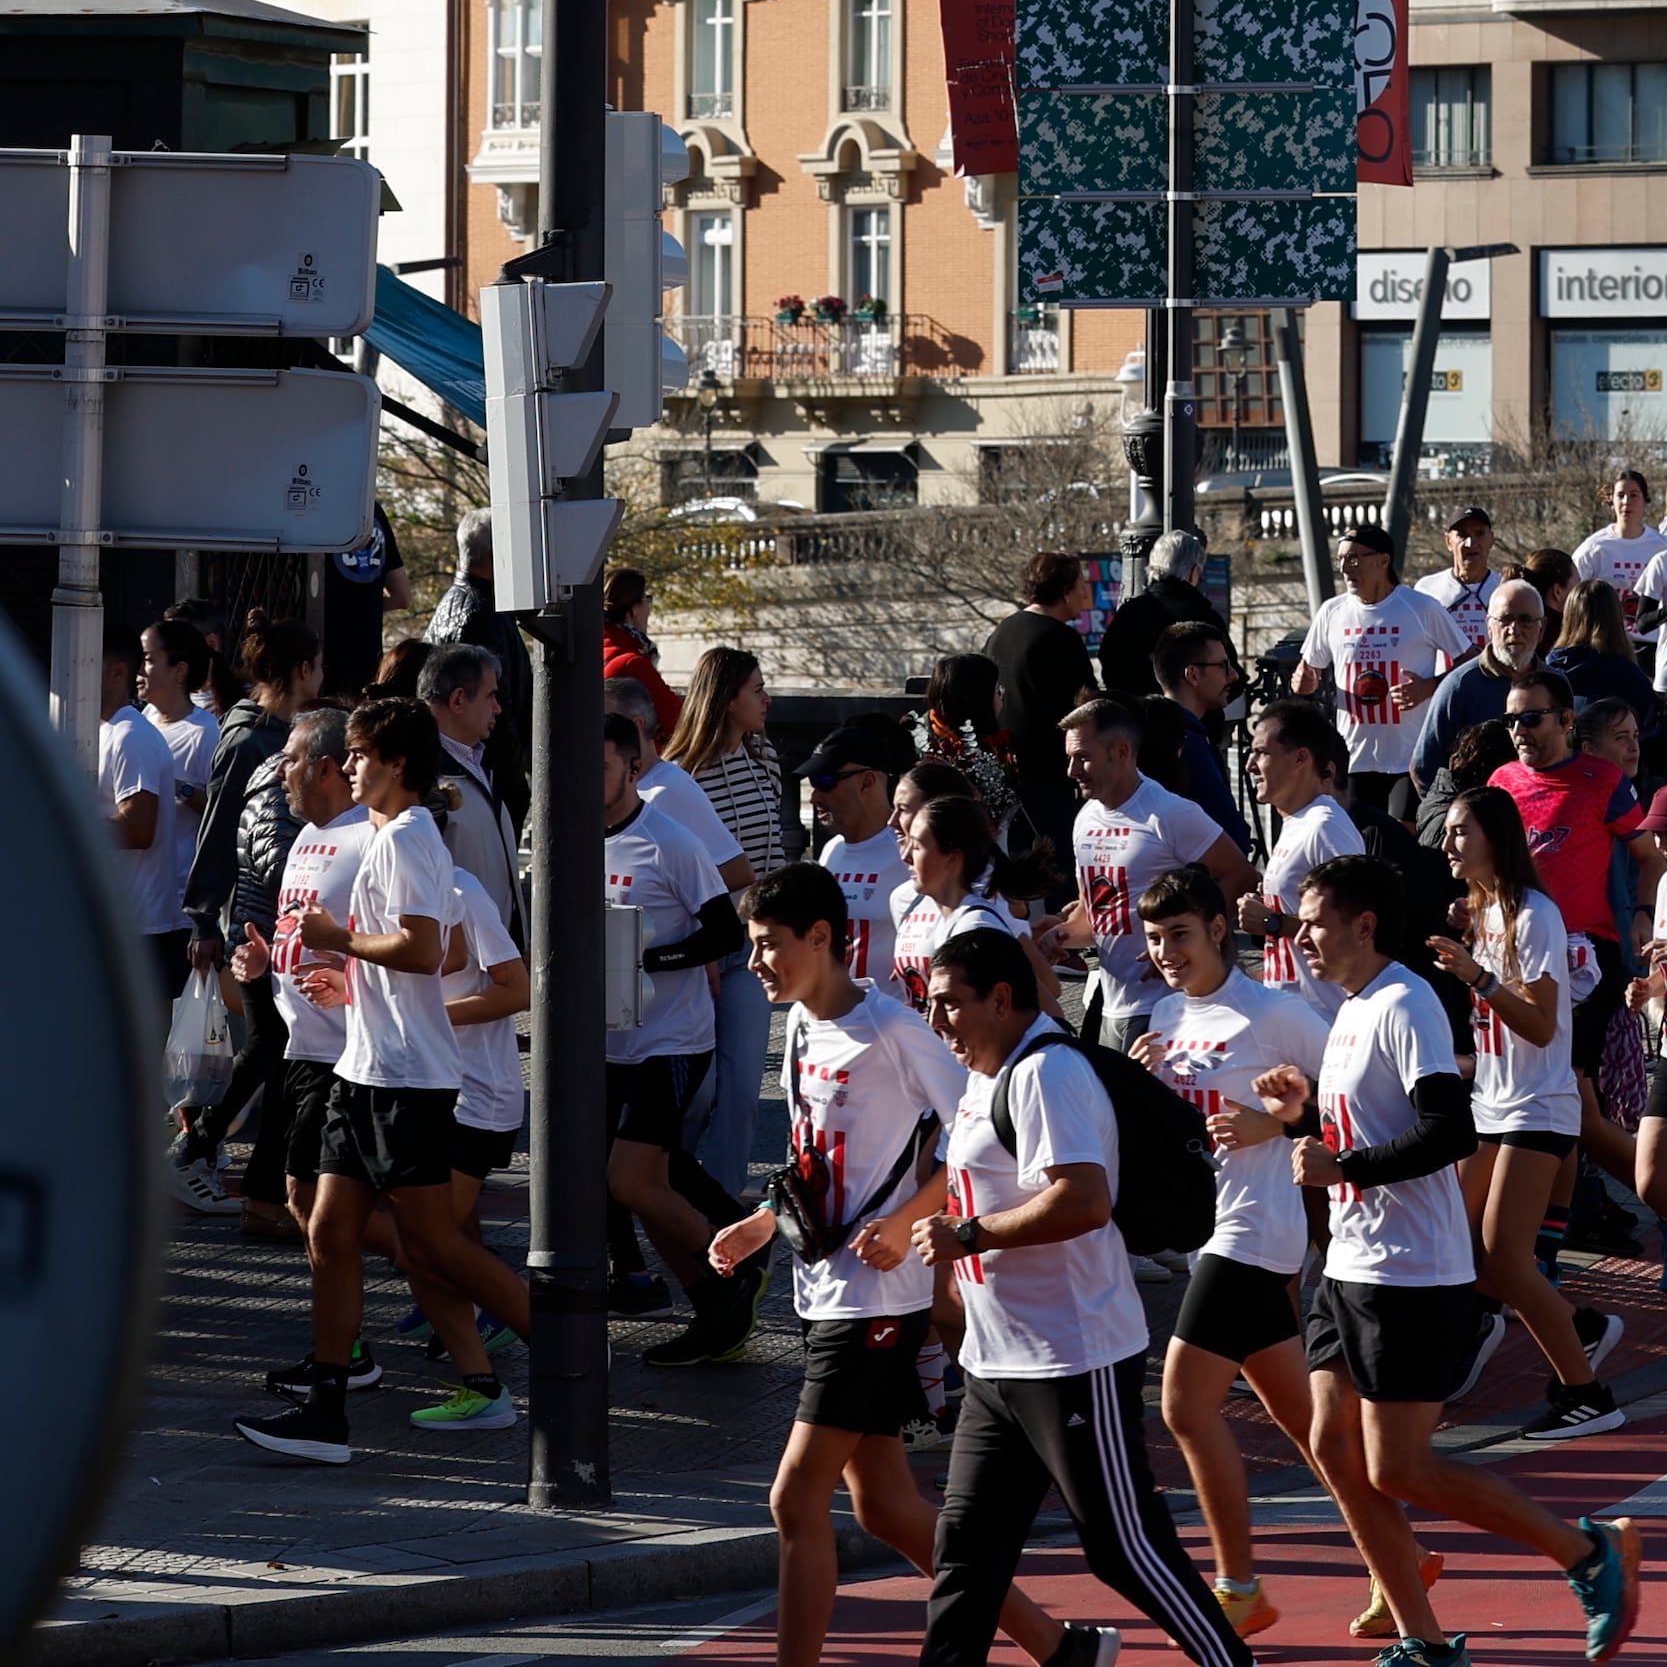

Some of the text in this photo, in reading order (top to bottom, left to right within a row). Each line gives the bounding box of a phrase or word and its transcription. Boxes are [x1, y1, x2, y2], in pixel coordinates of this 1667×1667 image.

[1369, 269, 1472, 303] diseo
[1598, 373, 1644, 390] efecto
[1462, 625, 1479, 633] 049
[1360, 651, 1381, 660] 2263
[1093, 853, 1111, 864] 4429
[1173, 1074, 1198, 1086] 4622
